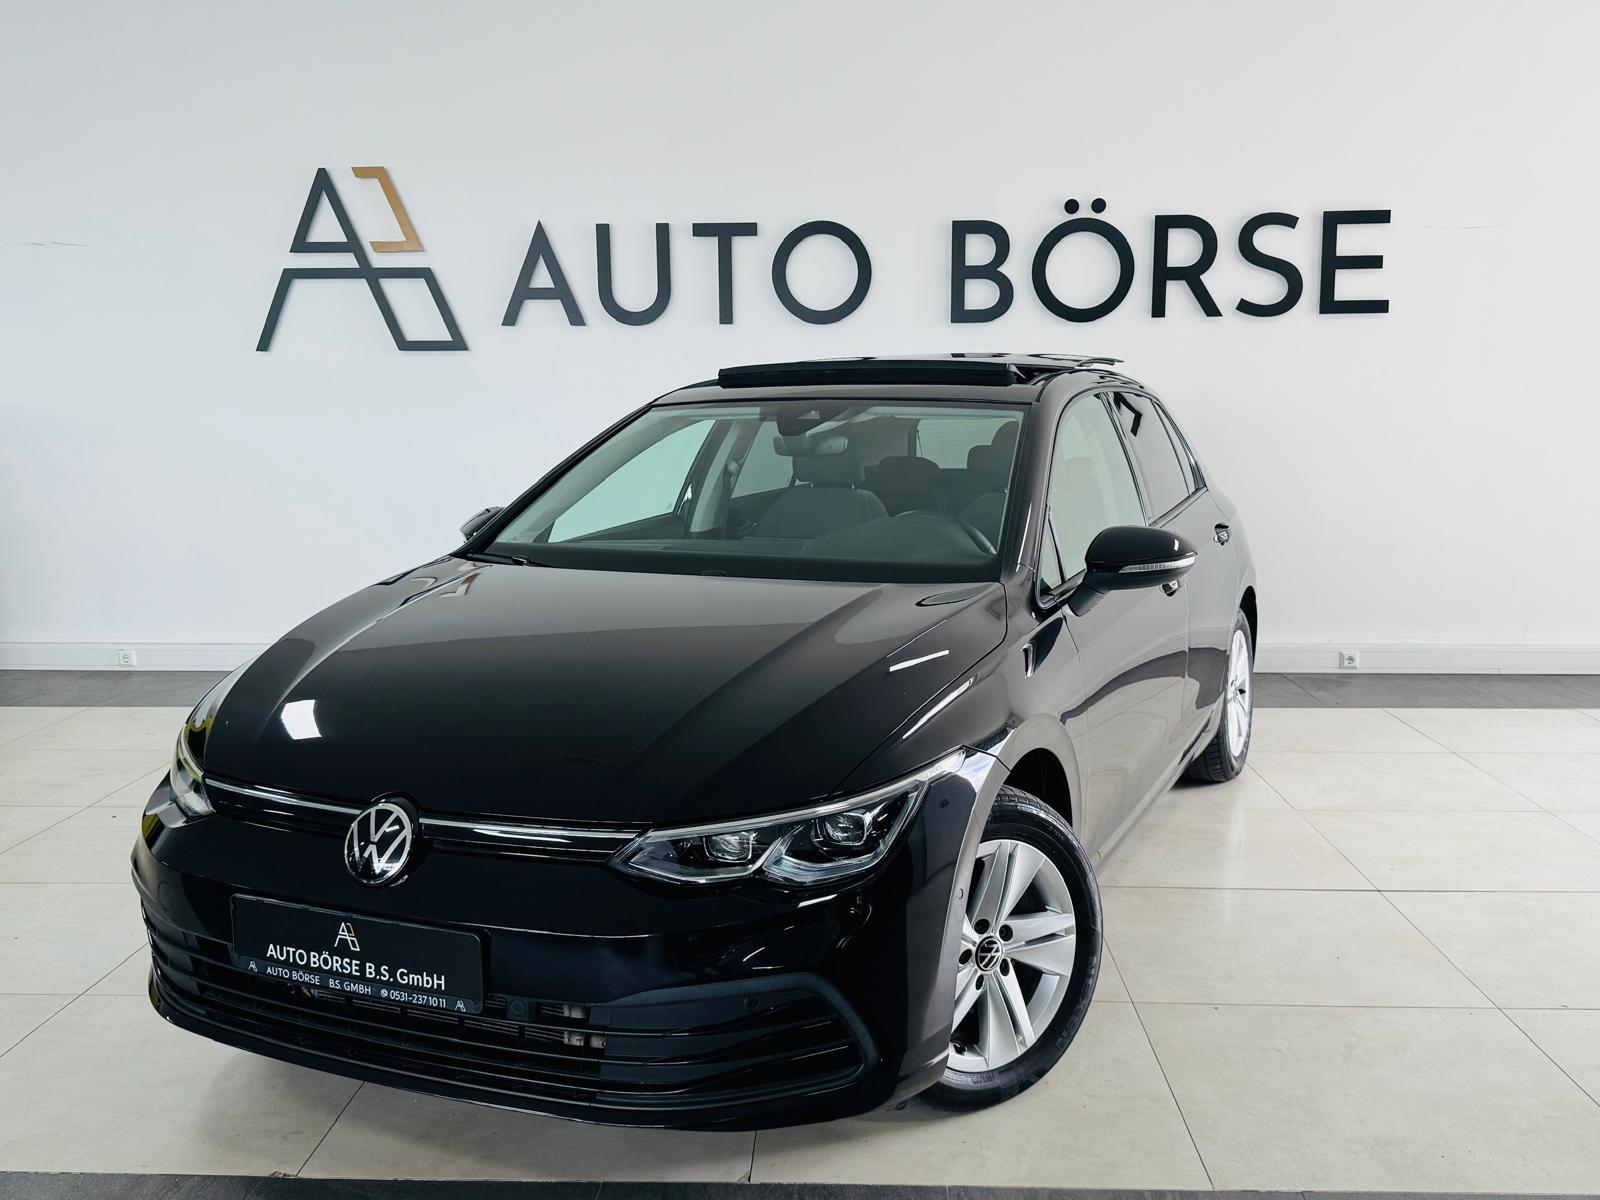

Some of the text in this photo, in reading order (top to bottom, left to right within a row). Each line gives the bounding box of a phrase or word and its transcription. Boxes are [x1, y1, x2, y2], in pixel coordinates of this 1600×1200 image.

[501, 198, 1391, 327] AUTO BÖRSE
[266, 943, 445, 990] AUTO BÖRSE B.S. GmbH
[266, 966, 290, 978] AUTO
[292, 971, 320, 985] BÖRSE
[343, 981, 371, 995] GMBH
